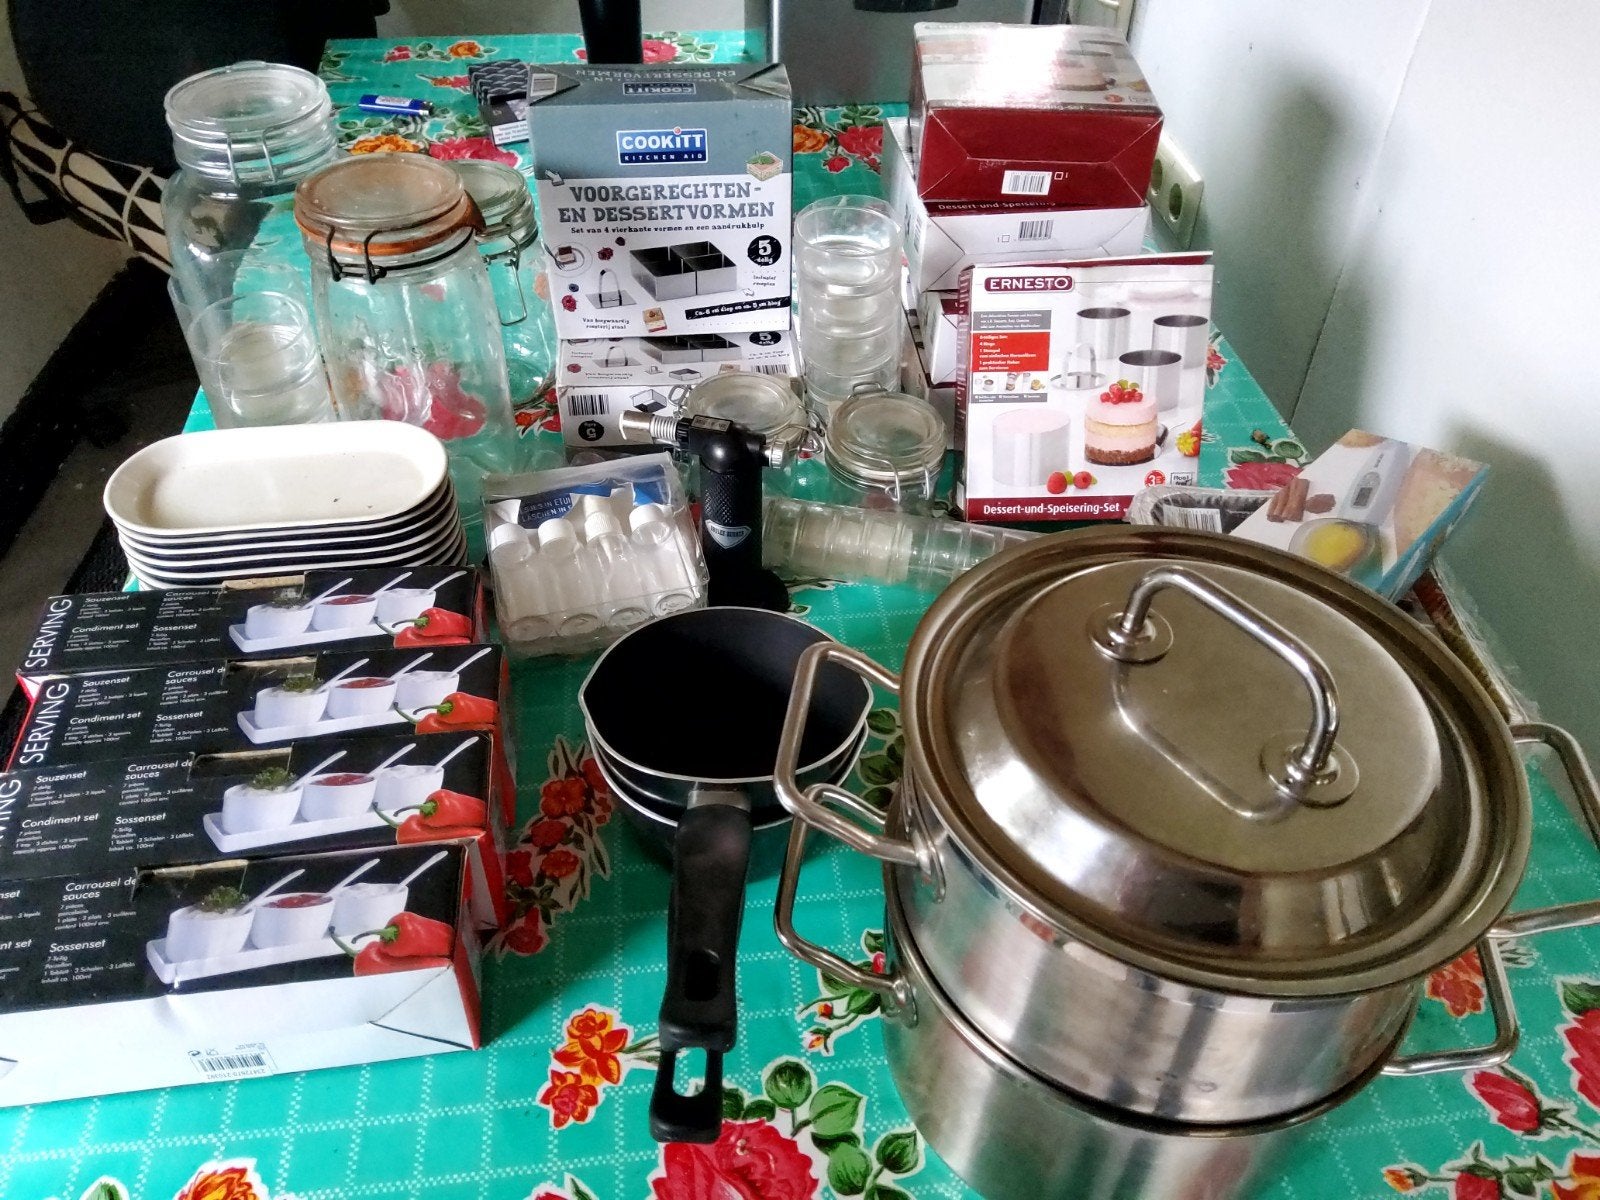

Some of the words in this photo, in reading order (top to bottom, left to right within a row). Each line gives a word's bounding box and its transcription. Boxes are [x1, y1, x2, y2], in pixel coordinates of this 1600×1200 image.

[624, 153, 675, 161] KITCHEN
[558, 207, 586, 223] EN
[592, 202, 775, 222] DESSERTVORMEN
[758, 239, 772, 255] 5
[990, 278, 1069, 290] ERNESTO
[1149, 474, 1156, 487] 3
[25, 599, 73, 668] SERVING
[72, 623, 124, 634] Condiment
[168, 668, 215, 678] Carrousel
[83, 676, 130, 688] Sauzenset
[166, 676, 197, 685] sauces
[70, 712, 124, 725] Condiment
[127, 711, 142, 719] set
[156, 711, 203, 721] Sossenset
[20, 682, 70, 764] SERVING
[128, 760, 178, 772] Carrousel
[36, 770, 87, 784] Sauzenset
[125, 771, 160, 781] sauces
[22, 814, 81, 828] Condiment
[83, 812, 99, 821] set
[115, 812, 166, 825] Sossenset
[66, 878, 121, 892] Carrousel
[62, 891, 100, 901] sauces
[14, 939, 32, 949] set
[49, 939, 106, 953] Sossenset
